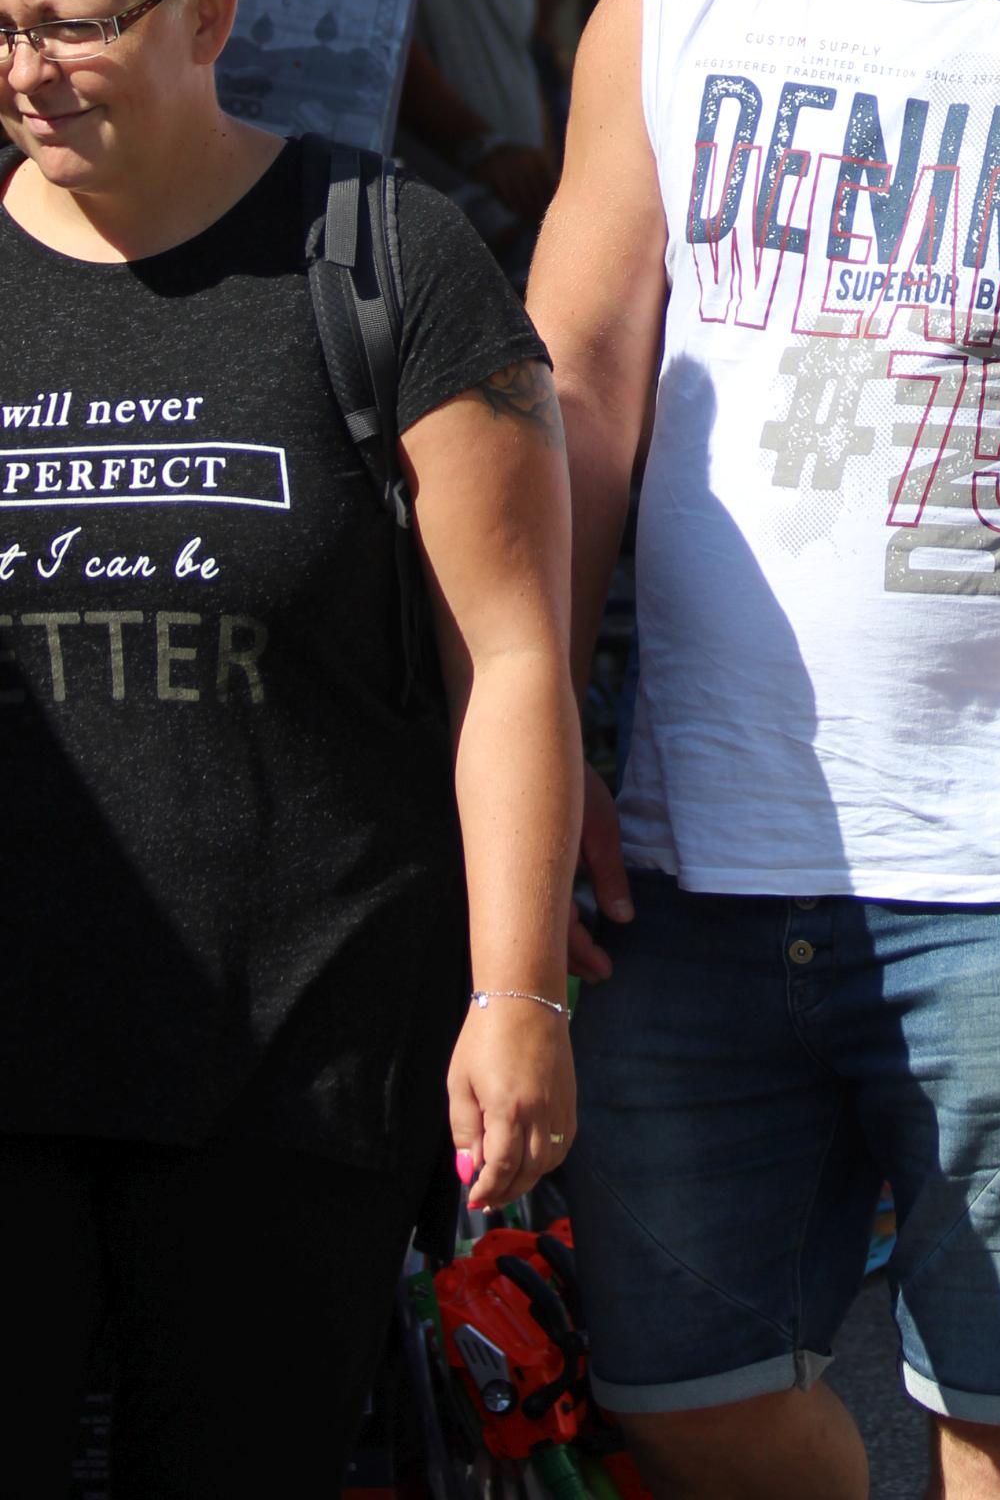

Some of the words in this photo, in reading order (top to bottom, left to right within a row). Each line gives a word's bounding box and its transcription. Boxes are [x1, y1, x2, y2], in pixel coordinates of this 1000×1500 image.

[745, 32, 807, 49] CUSTOM
[819, 39, 882, 57] SUPPLY
[694, 59, 777, 74] REGISTERED
[785, 65, 862, 85] TRADEMARK
[801, 55, 855, 70] LIMITED
[863, 63, 917, 78] EDITION
[836, 268, 960, 306] SUPERIOR
[1, 391, 72, 428] will
[86, 396, 204, 425] never
[3, 456, 226, 493] PERFECT
[37, 526, 82, 578] I
[85, 555, 156, 578] can
[175, 537, 220, 580] be
